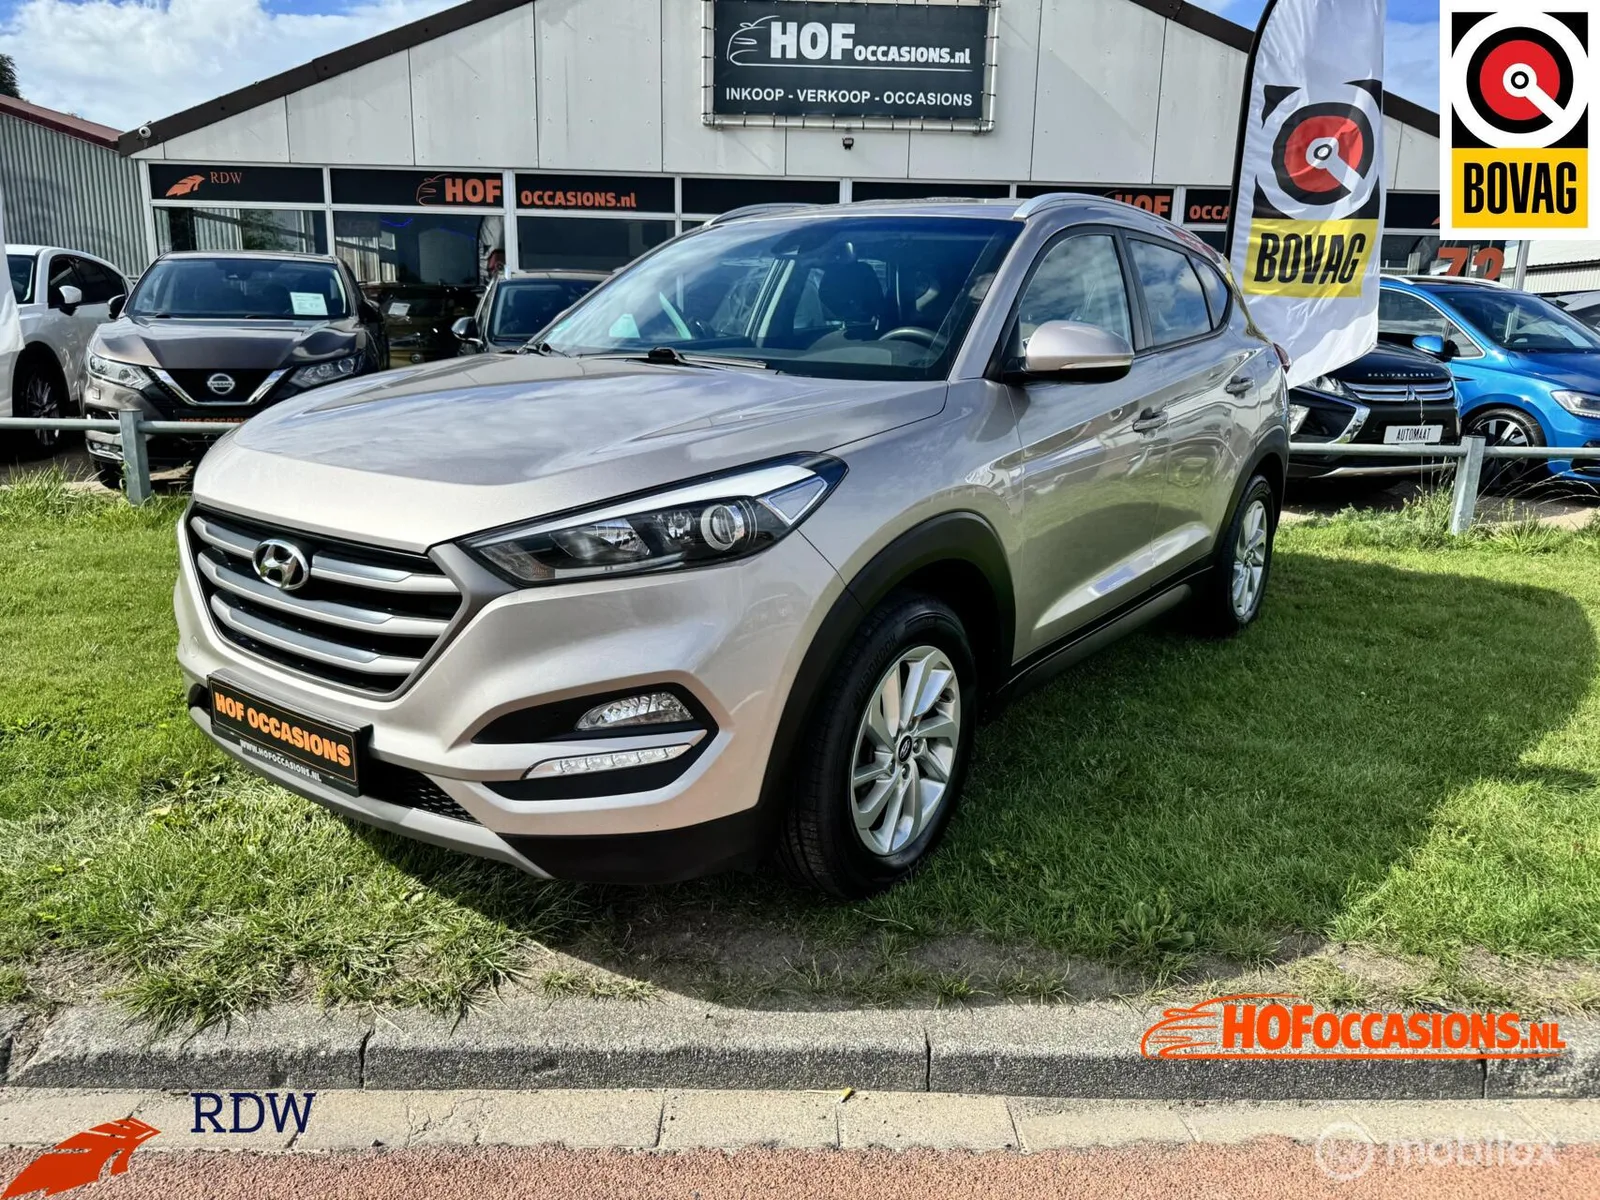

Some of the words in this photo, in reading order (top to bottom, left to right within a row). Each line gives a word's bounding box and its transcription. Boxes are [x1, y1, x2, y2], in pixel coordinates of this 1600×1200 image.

[726, 87, 785, 101] INKOOP
[797, 88, 871, 104] VERKOOP
[883, 90, 973, 107] OCCASIONS
[210, 171, 242, 185] RDW
[445, 179, 501, 203] HOF
[521, 191, 636, 207] OCCASIONS.nl
[1253, 232, 1367, 285] BOVAG
[1396, 428, 1432, 440] AUTOMAAT
[214, 692, 245, 721] HOF
[247, 707, 351, 767] OCCASIONS
